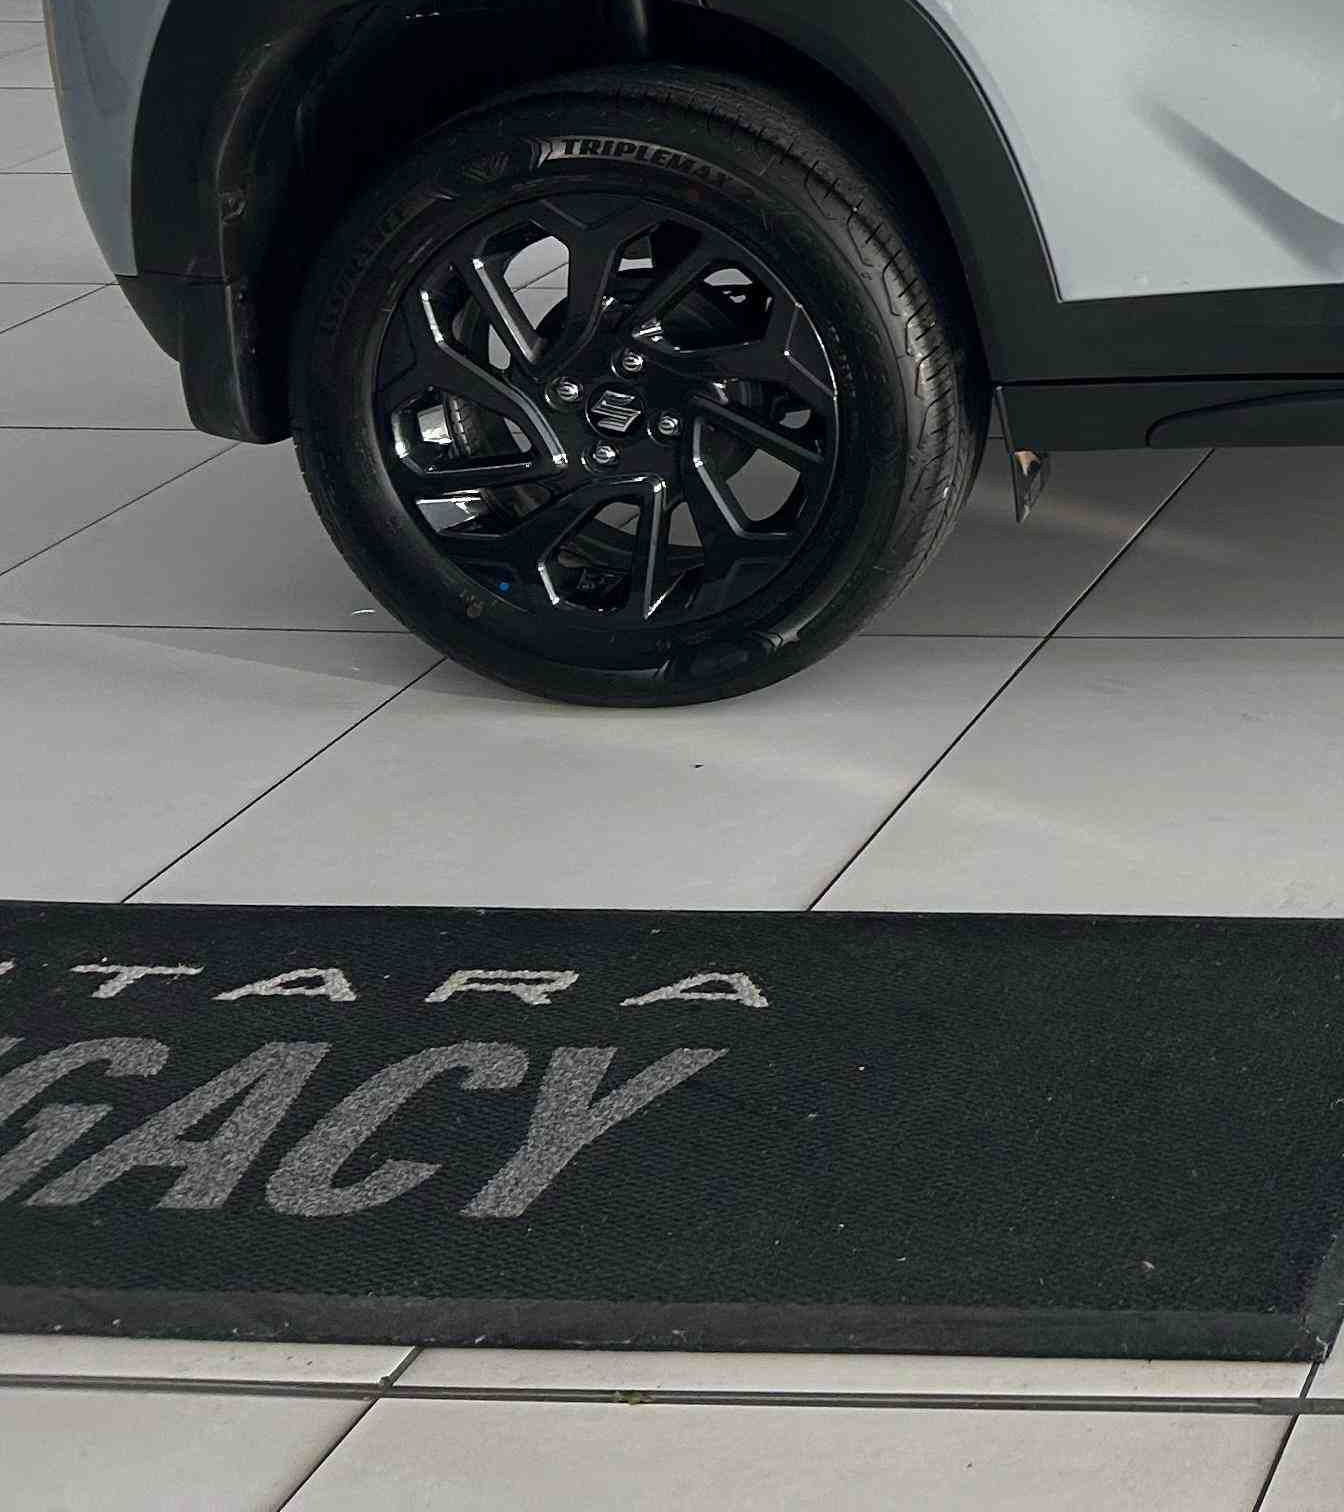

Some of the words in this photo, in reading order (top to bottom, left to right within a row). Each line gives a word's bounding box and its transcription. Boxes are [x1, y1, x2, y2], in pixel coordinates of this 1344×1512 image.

[562, 138, 735, 187] TRIPLEMAX
[0, 960, 769, 1008] TARA
[0, 1035, 730, 1218] GACY
